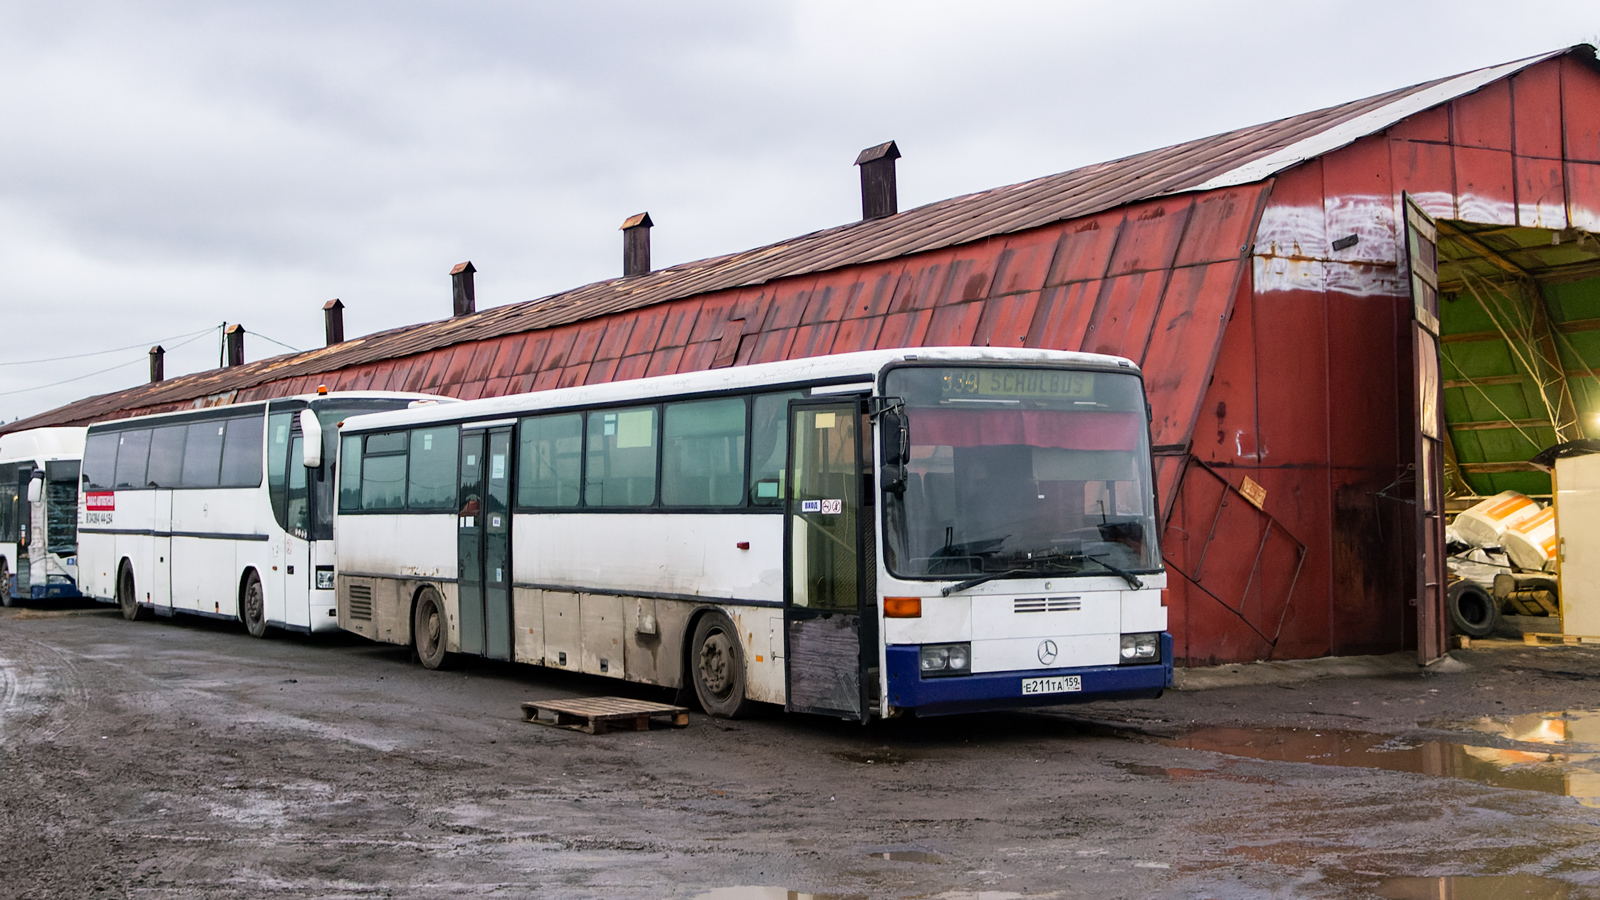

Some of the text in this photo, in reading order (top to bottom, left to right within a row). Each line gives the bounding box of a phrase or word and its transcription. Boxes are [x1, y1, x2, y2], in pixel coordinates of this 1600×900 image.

[804, 501, 818, 510] ВХОД
[1025, 676, 1079, 693] Е211ТА 159
